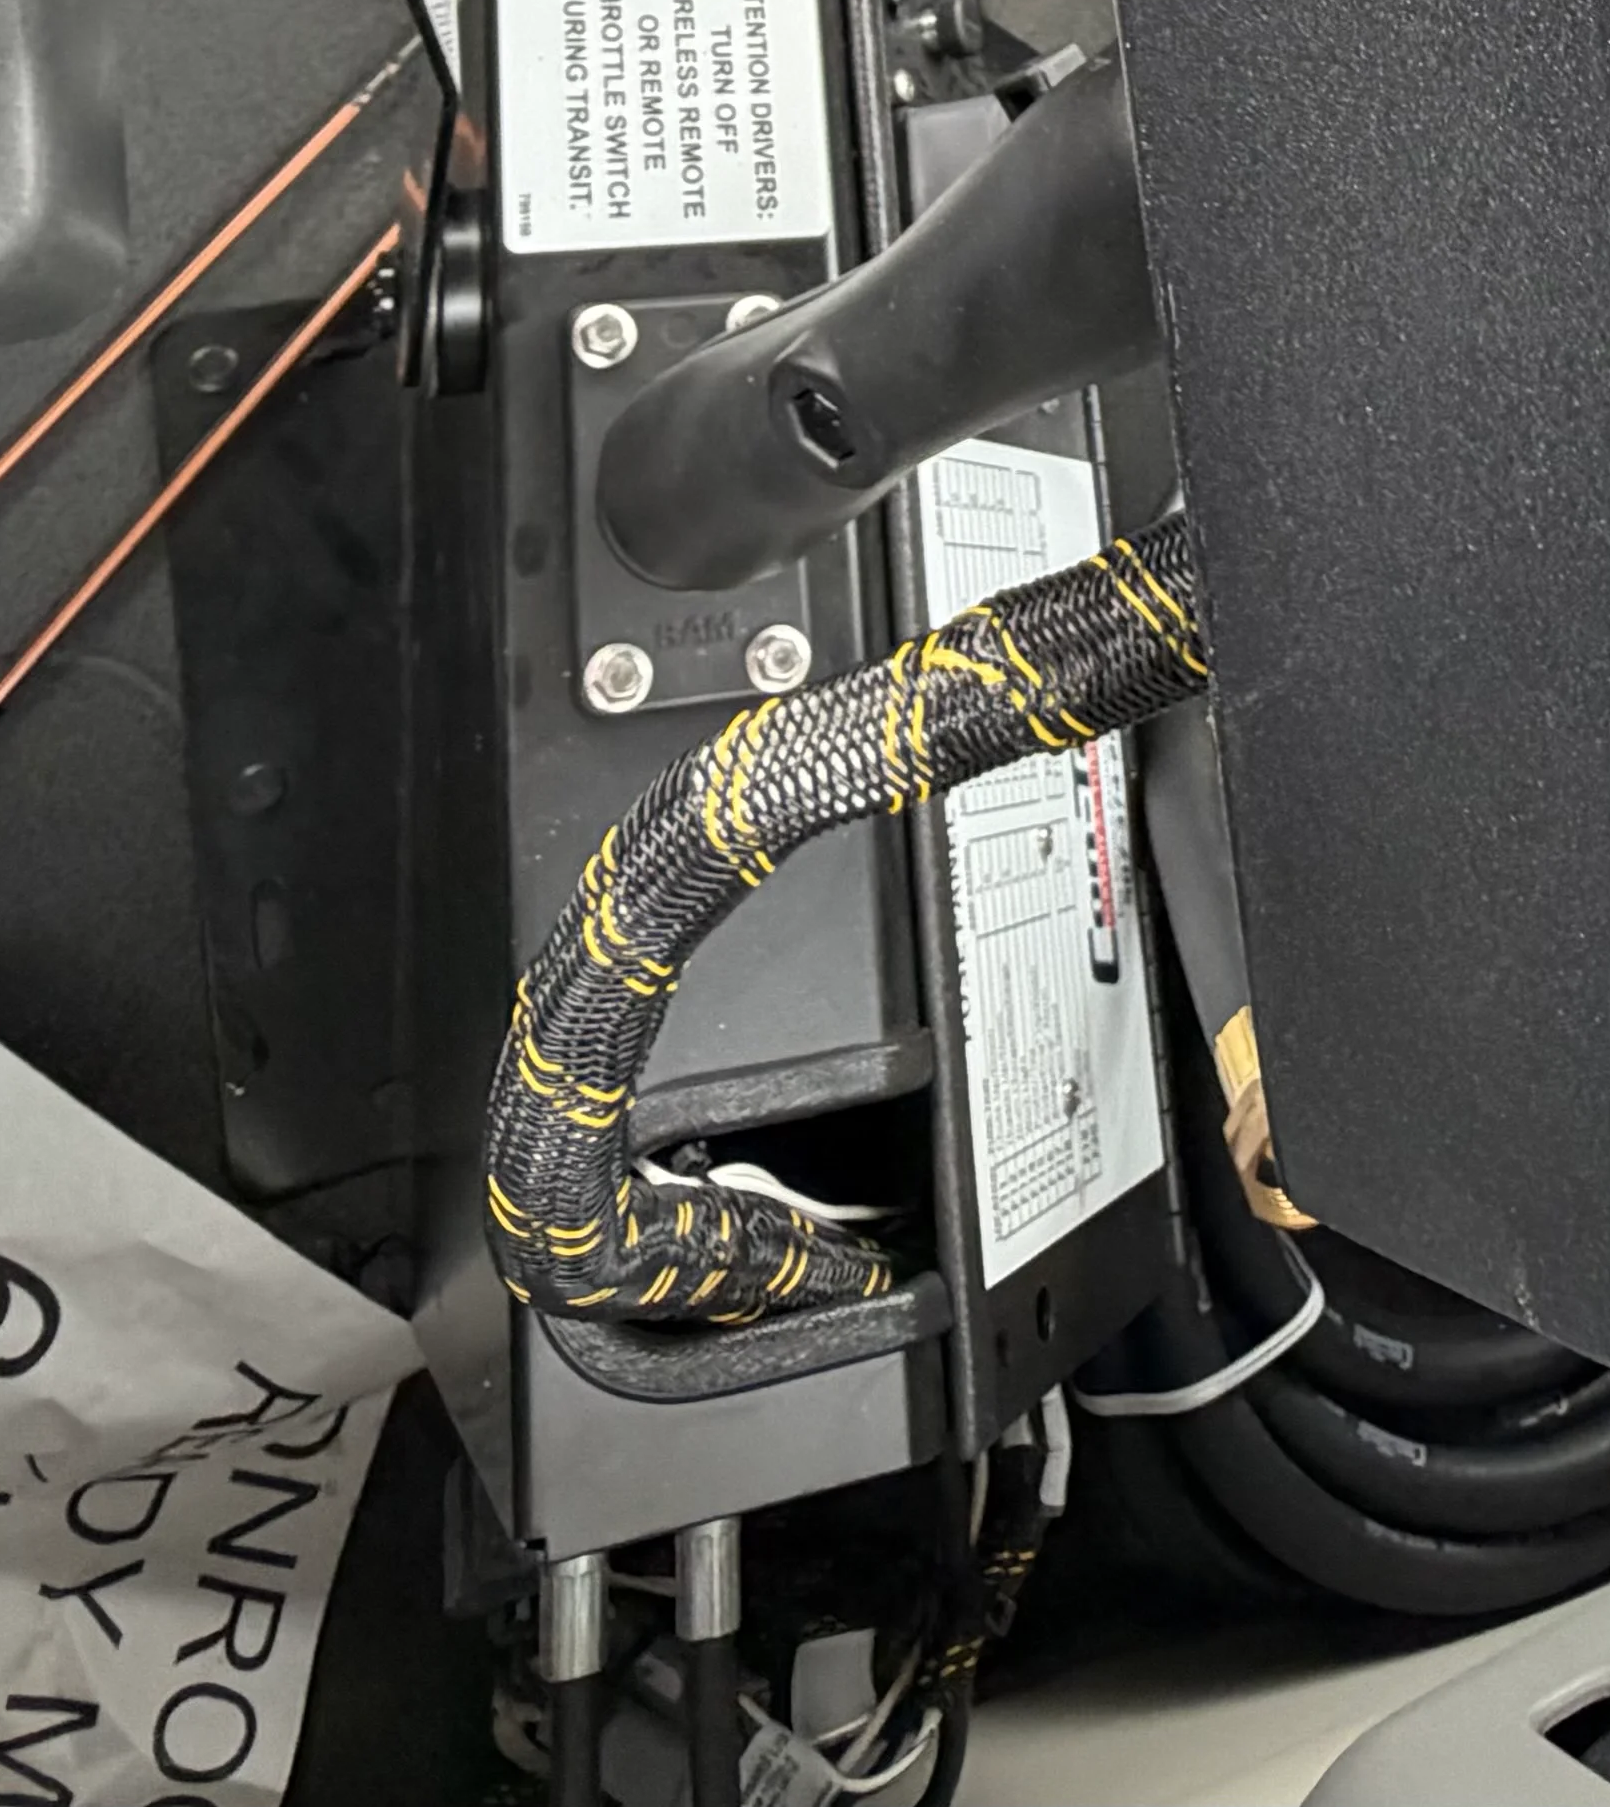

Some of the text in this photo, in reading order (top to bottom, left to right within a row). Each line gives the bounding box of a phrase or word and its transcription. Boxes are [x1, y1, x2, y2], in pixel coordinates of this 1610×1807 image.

[636, 13, 667, 171] OR REMOTE
[709, 25, 737, 154] TURN OFF
[562, 89, 595, 210] TRANSIT.
[602, 114, 631, 219] SWITCH
[676, 106, 705, 218] REMOTE
[749, 102, 778, 220] DRIVERS:
